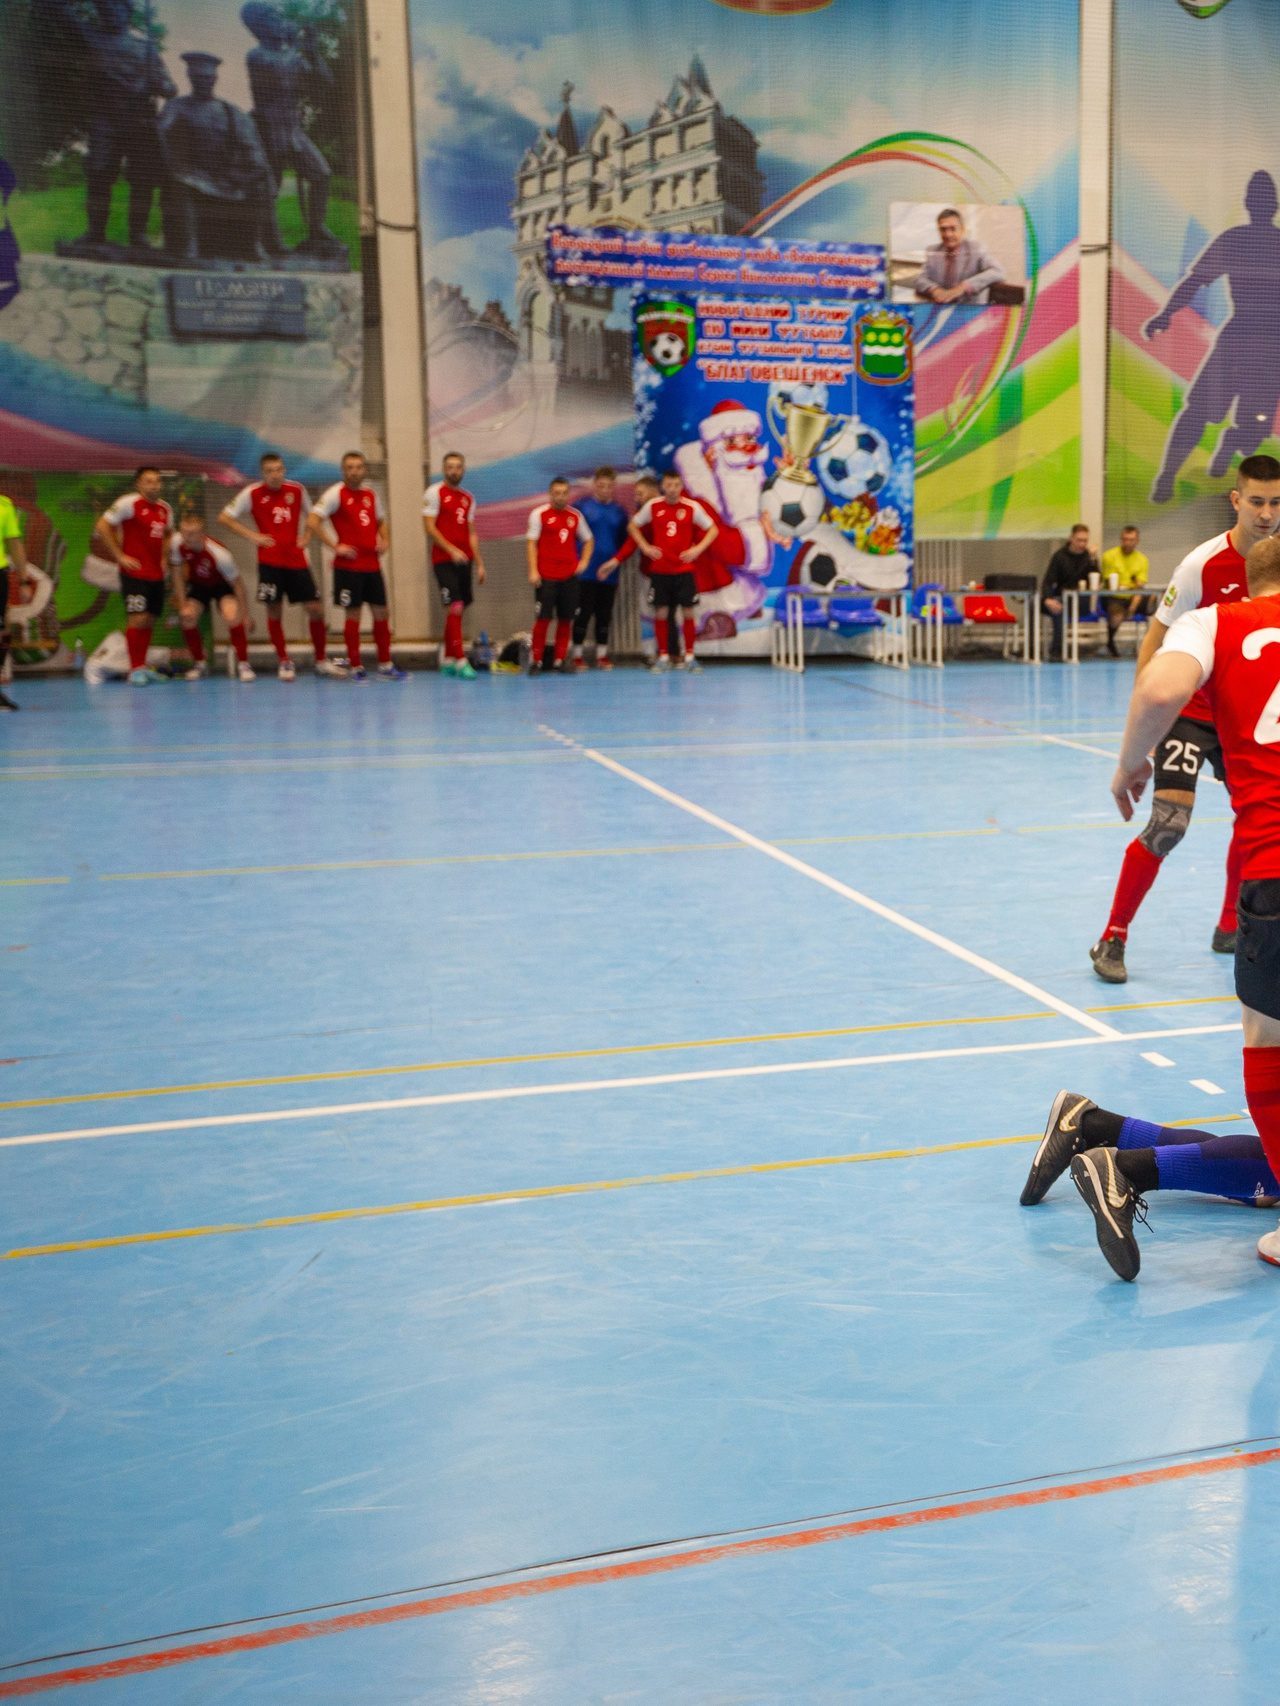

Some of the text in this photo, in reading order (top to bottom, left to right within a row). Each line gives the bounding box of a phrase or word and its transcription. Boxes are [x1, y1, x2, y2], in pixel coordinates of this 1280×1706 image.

[358, 509, 371, 527] 5
[666, 521, 677, 537] 3
[1162, 739, 1201, 775] 25
